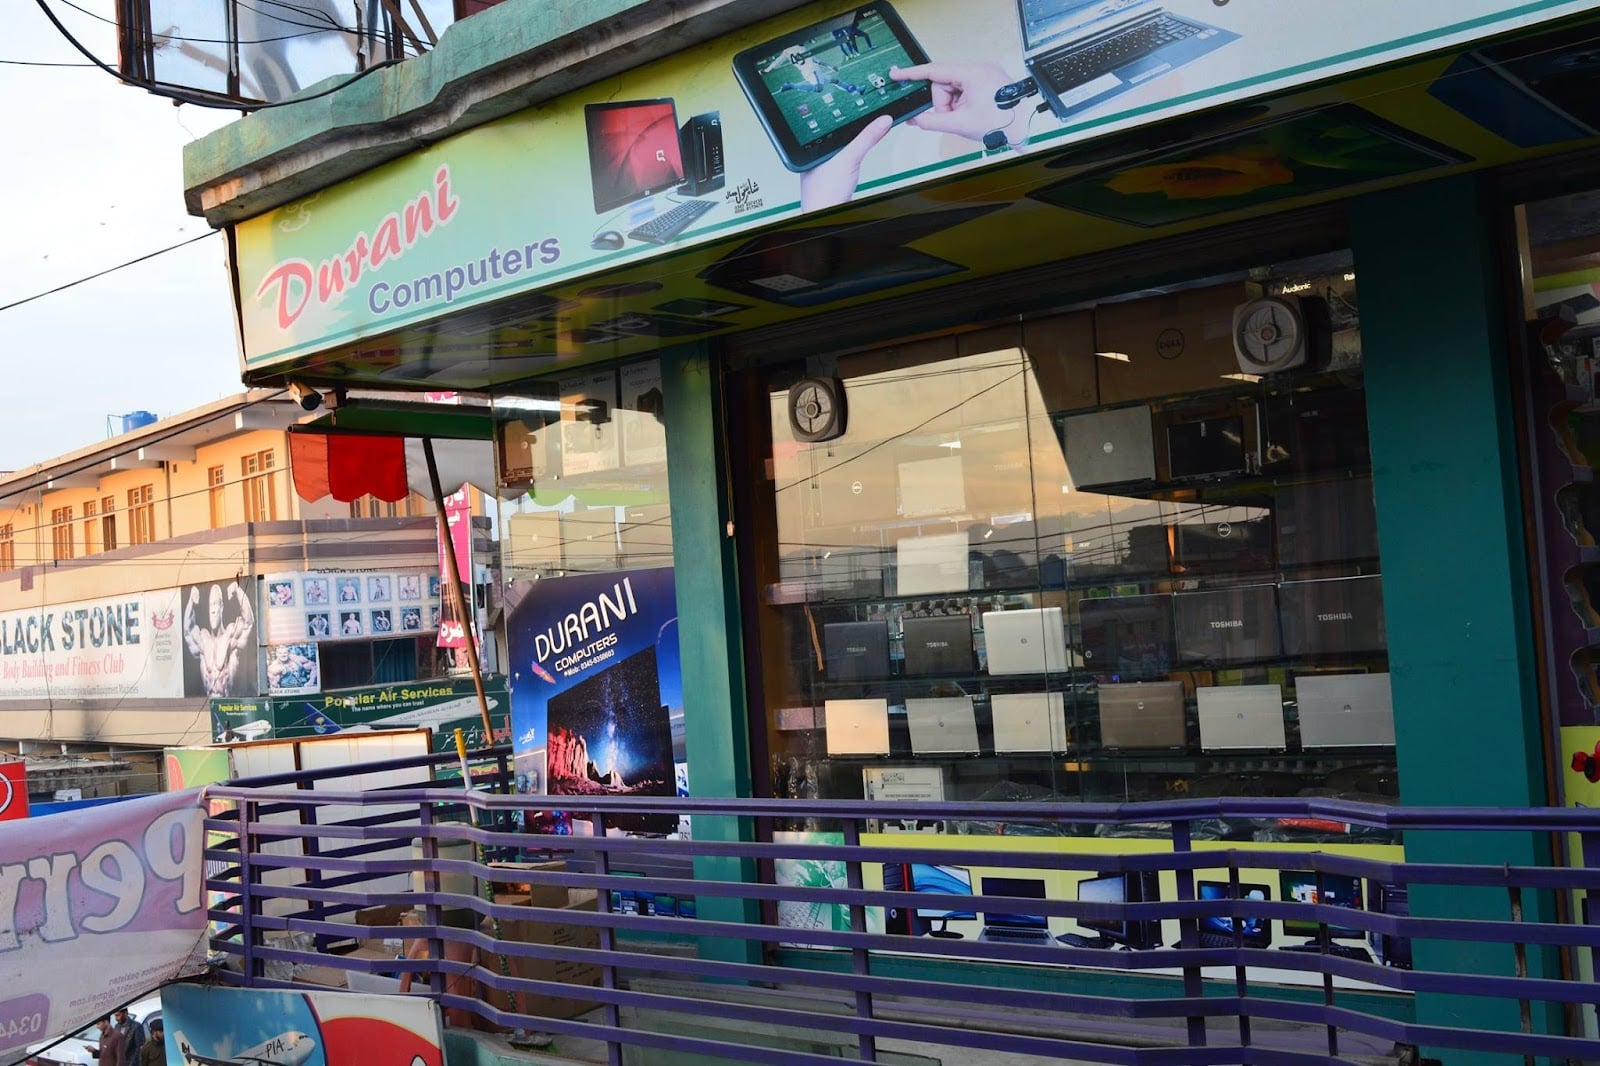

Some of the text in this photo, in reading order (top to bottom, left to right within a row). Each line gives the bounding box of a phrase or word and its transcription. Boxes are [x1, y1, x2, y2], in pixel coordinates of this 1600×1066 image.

[256, 167, 458, 329] Durani
[369, 237, 562, 314] Computers
[1281, 280, 1311, 294] Audionic
[534, 577, 638, 663] DURANI
[1210, 620, 1244, 629] TOSHIBA
[1317, 612, 1353, 622] TOSHIBA
[0, 613, 55, 655] LACK
[62, 602, 140, 651] STONE
[554, 633, 618, 672] COMPUTERS
[3, 653, 124, 683] Body Building and Fitness Club
[566, 664, 580, 678] Mob:
[379, 690, 397, 703] Air
[401, 686, 453, 701] Services
[352, 705, 362, 713] The
[266, 1039, 285, 1058] PIA
